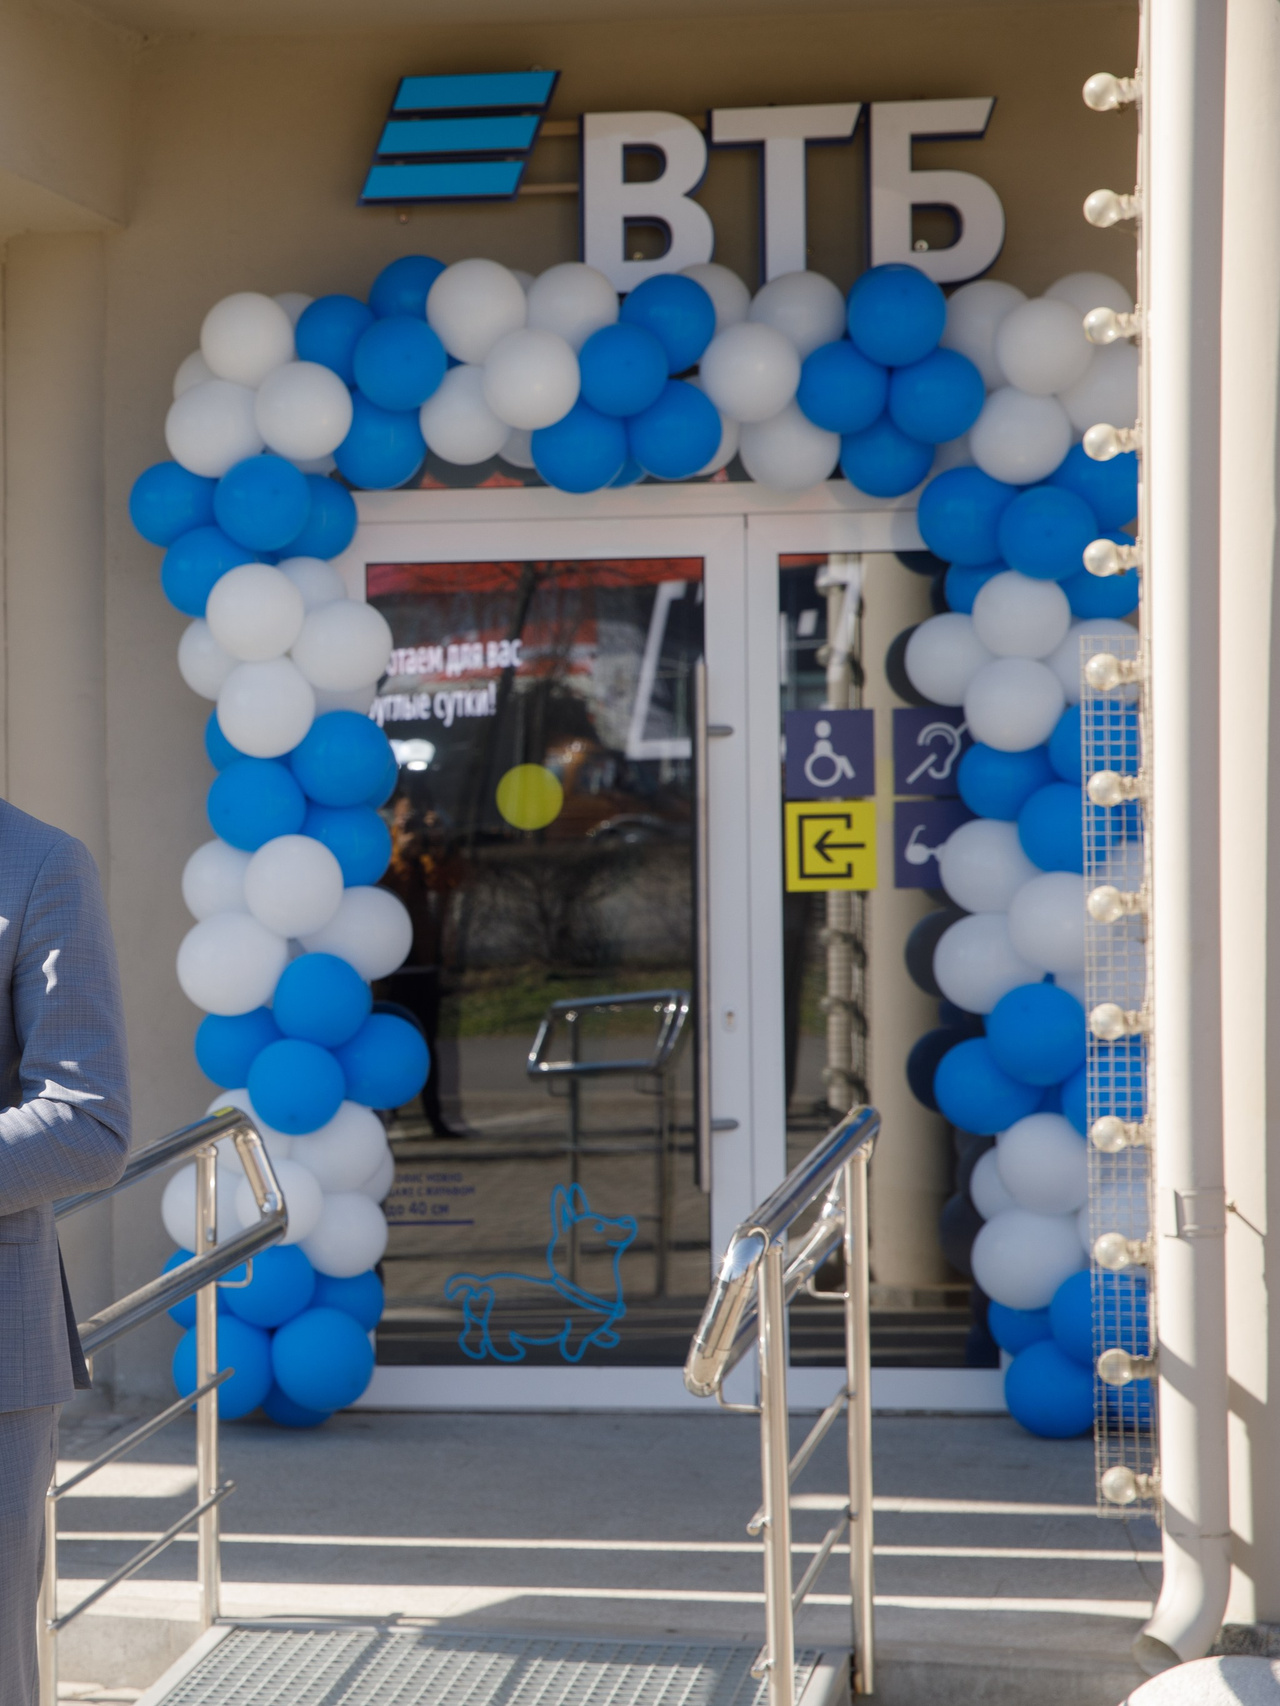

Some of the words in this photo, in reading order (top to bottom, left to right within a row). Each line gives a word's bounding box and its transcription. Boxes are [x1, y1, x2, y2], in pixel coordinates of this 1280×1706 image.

[580, 96, 1006, 297] ВТБ
[445, 642, 484, 677] для
[486, 638, 523, 668] вас
[433, 680, 497, 728] сутки!
[409, 1201, 426, 1215] 40
